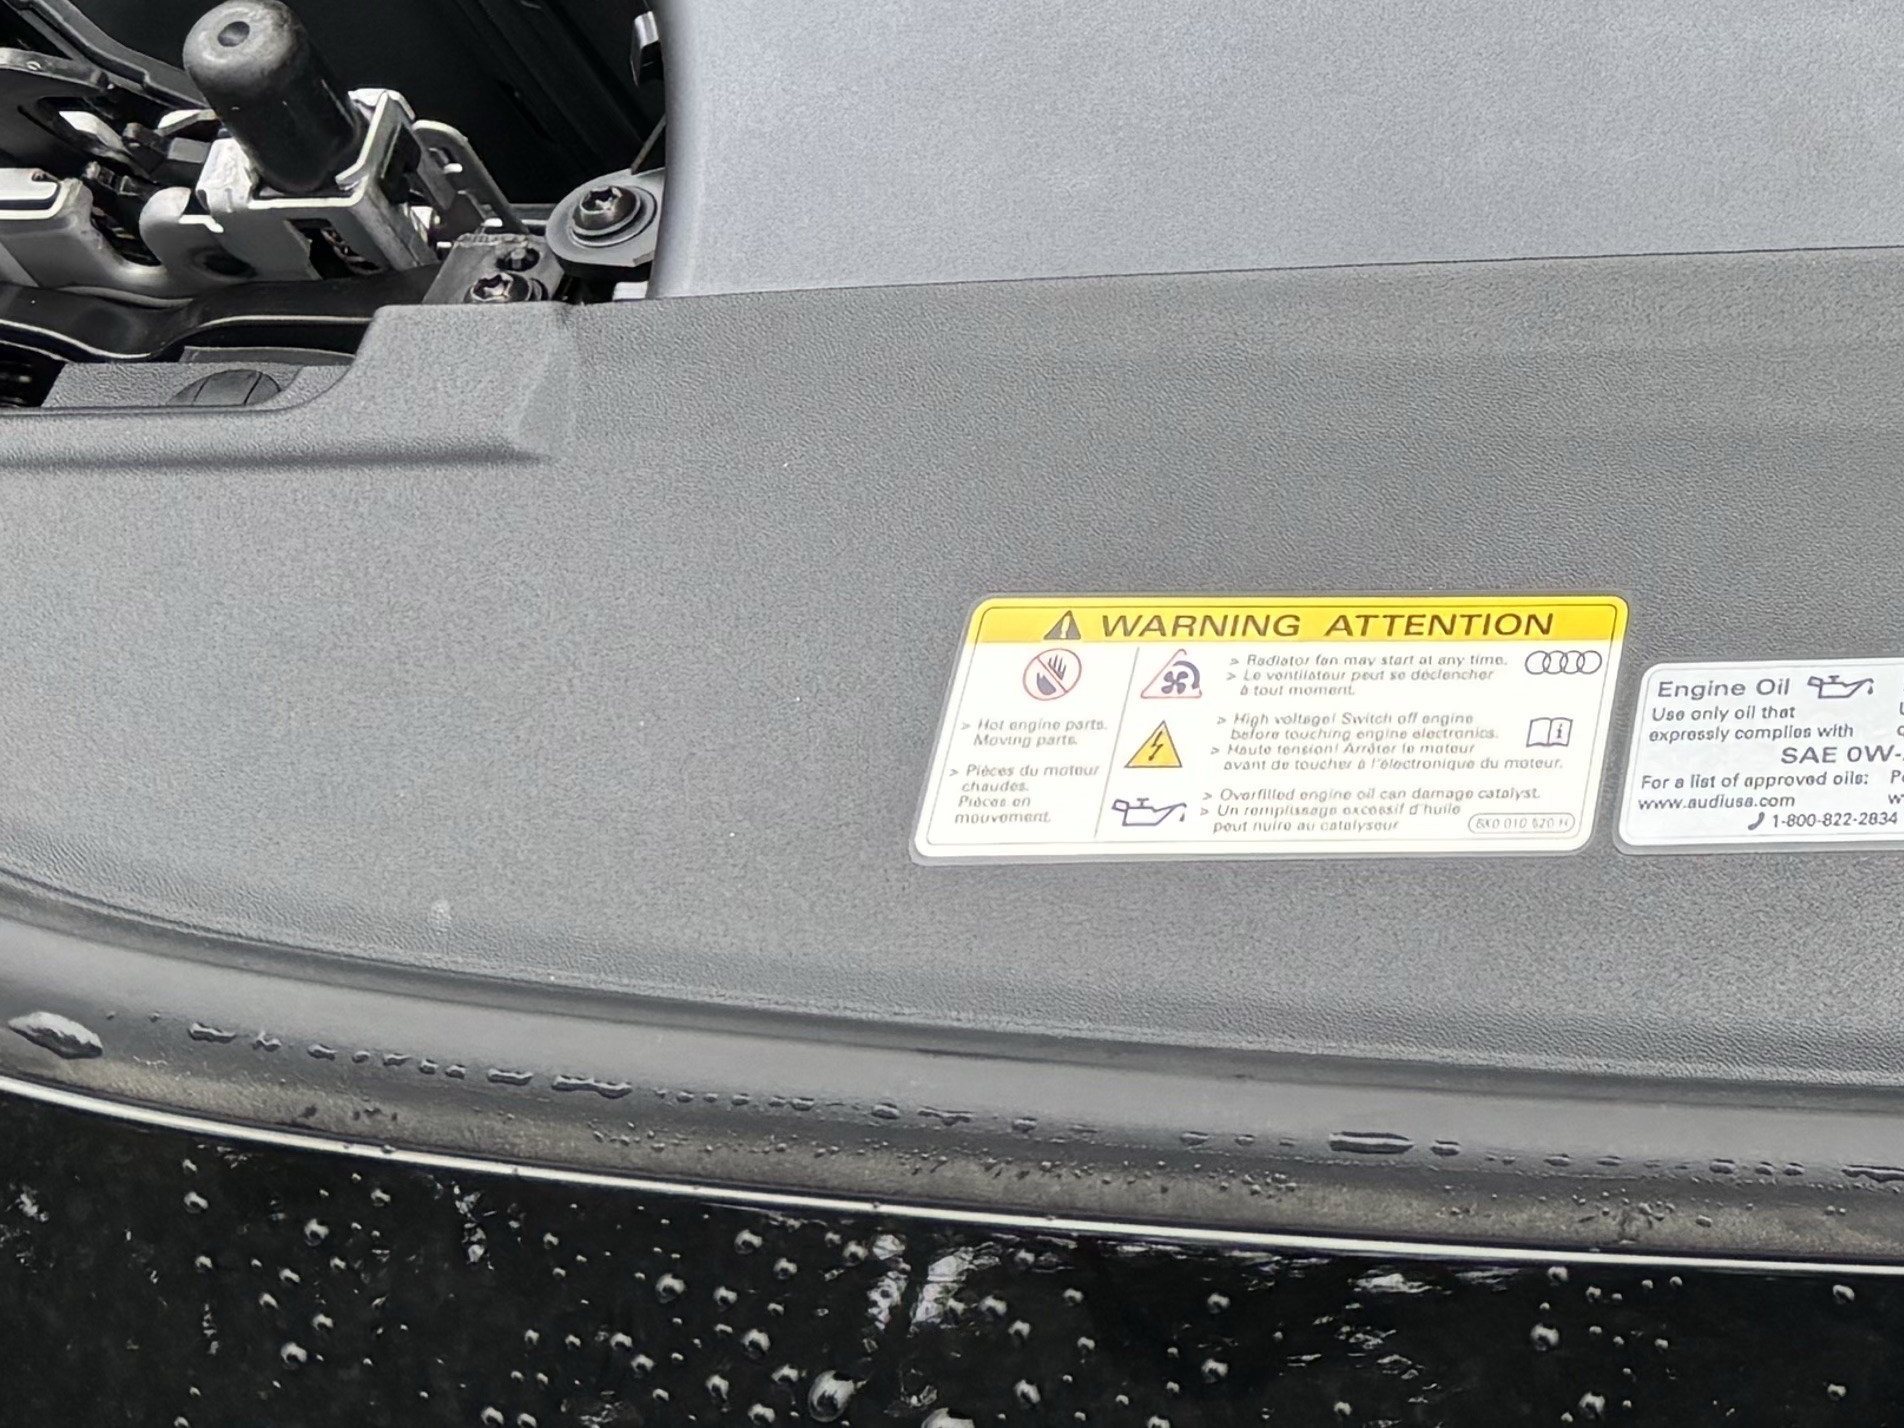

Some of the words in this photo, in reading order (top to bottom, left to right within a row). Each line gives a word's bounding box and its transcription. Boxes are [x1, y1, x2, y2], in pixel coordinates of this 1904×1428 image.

[1101, 613, 1301, 637] WARNING
[1324, 612, 1555, 637] ATTENTION
[1247, 654, 1310, 666] Radiator
[1315, 654, 1338, 666] fan
[1344, 655, 1376, 668] may
[1381, 655, 1414, 666] start
[1419, 655, 1432, 666] at
[1438, 655, 1464, 668] any
[1470, 654, 1508, 666] time.
[1243, 670, 1261, 681] Le
[1266, 670, 1346, 681] ventilateur
[1351, 670, 1385, 683] peut
[1389, 671, 1405, 681] se
[1410, 669, 1494, 681] déclencher
[1253, 684, 1283, 696] tout
[1288, 685, 1356, 696] moment.
[1658, 679, 1746, 701] Engine
[1755, 677, 1791, 696] Oil
[1233, 713, 1268, 728] High
[1274, 713, 1337, 728] voltage!
[1341, 713, 1393, 725] Switch
[1397, 712, 1418, 725] off
[1422, 714, 1474, 728] engine
[1651, 707, 1685, 722] Use
[1690, 706, 1729, 723] only
[1734, 705, 1756, 720] oil
[1761, 705, 1796, 720] that
[978, 718, 1004, 731] Hot
[1009, 719, 1061, 734] engine
[1065, 719, 1108, 733] parts.
[1649, 726, 1731, 745] expressly
[1734, 724, 1812, 743] complies
[1817, 723, 1854, 738] with
[973, 734, 1032, 749] Moving
[1036, 734, 1078, 747] parts.
[1230, 727, 1280, 741] before
[1285, 727, 1352, 743] touching
[1356, 728, 1408, 743] engine
[1412, 727, 1499, 740] electronics.
[1227, 744, 1272, 756] Haute
[1277, 743, 1339, 755] tension!
[1343, 743, 1398, 755] Arrêter
[1402, 743, 1414, 755] le
[1419, 744, 1476, 755] moteur
[1781, 745, 1838, 764] SAE
[966, 764, 1015, 777] Pièces
[1020, 764, 1039, 777] du
[1043, 764, 1100, 777] moteur
[1223, 759, 1266, 771] avant
[1271, 758, 1289, 770] de
[1294, 758, 1352, 770] toucher
[1480, 757, 1499, 769] du
[1504, 757, 1564, 769] moteur.
[961, 781, 1029, 793] chaudes.
[1641, 774, 1670, 790] For
[1674, 777, 1685, 789] a
[1690, 774, 1716, 789] list
[1721, 773, 1741, 788] of
[1744, 771, 1828, 791] approved
[1832, 771, 1870, 786] oils:
[958, 795, 1007, 808] Pièces
[1012, 796, 1031, 808] en
[1220, 788, 1295, 802] Overfilled
[1300, 789, 1353, 804] engine
[1357, 788, 1376, 801] oil
[1380, 790, 1407, 801] can
[1411, 788, 1474, 804] damage
[1477, 787, 1541, 803] catalyst.
[1637, 795, 1797, 811] www.audiusa.com
[954, 812, 1051, 825] mouvement.
[1217, 804, 1239, 816] Un
[1243, 804, 1338, 820] remplissage
[1342, 803, 1405, 816] excessif
[1213, 820, 1248, 834] peut
[1253, 820, 1292, 832] nuire
[1297, 821, 1316, 832] au
[1320, 819, 1400, 834] catalyseur
[1772, 811, 1900, 829] 1-800-822-2834
